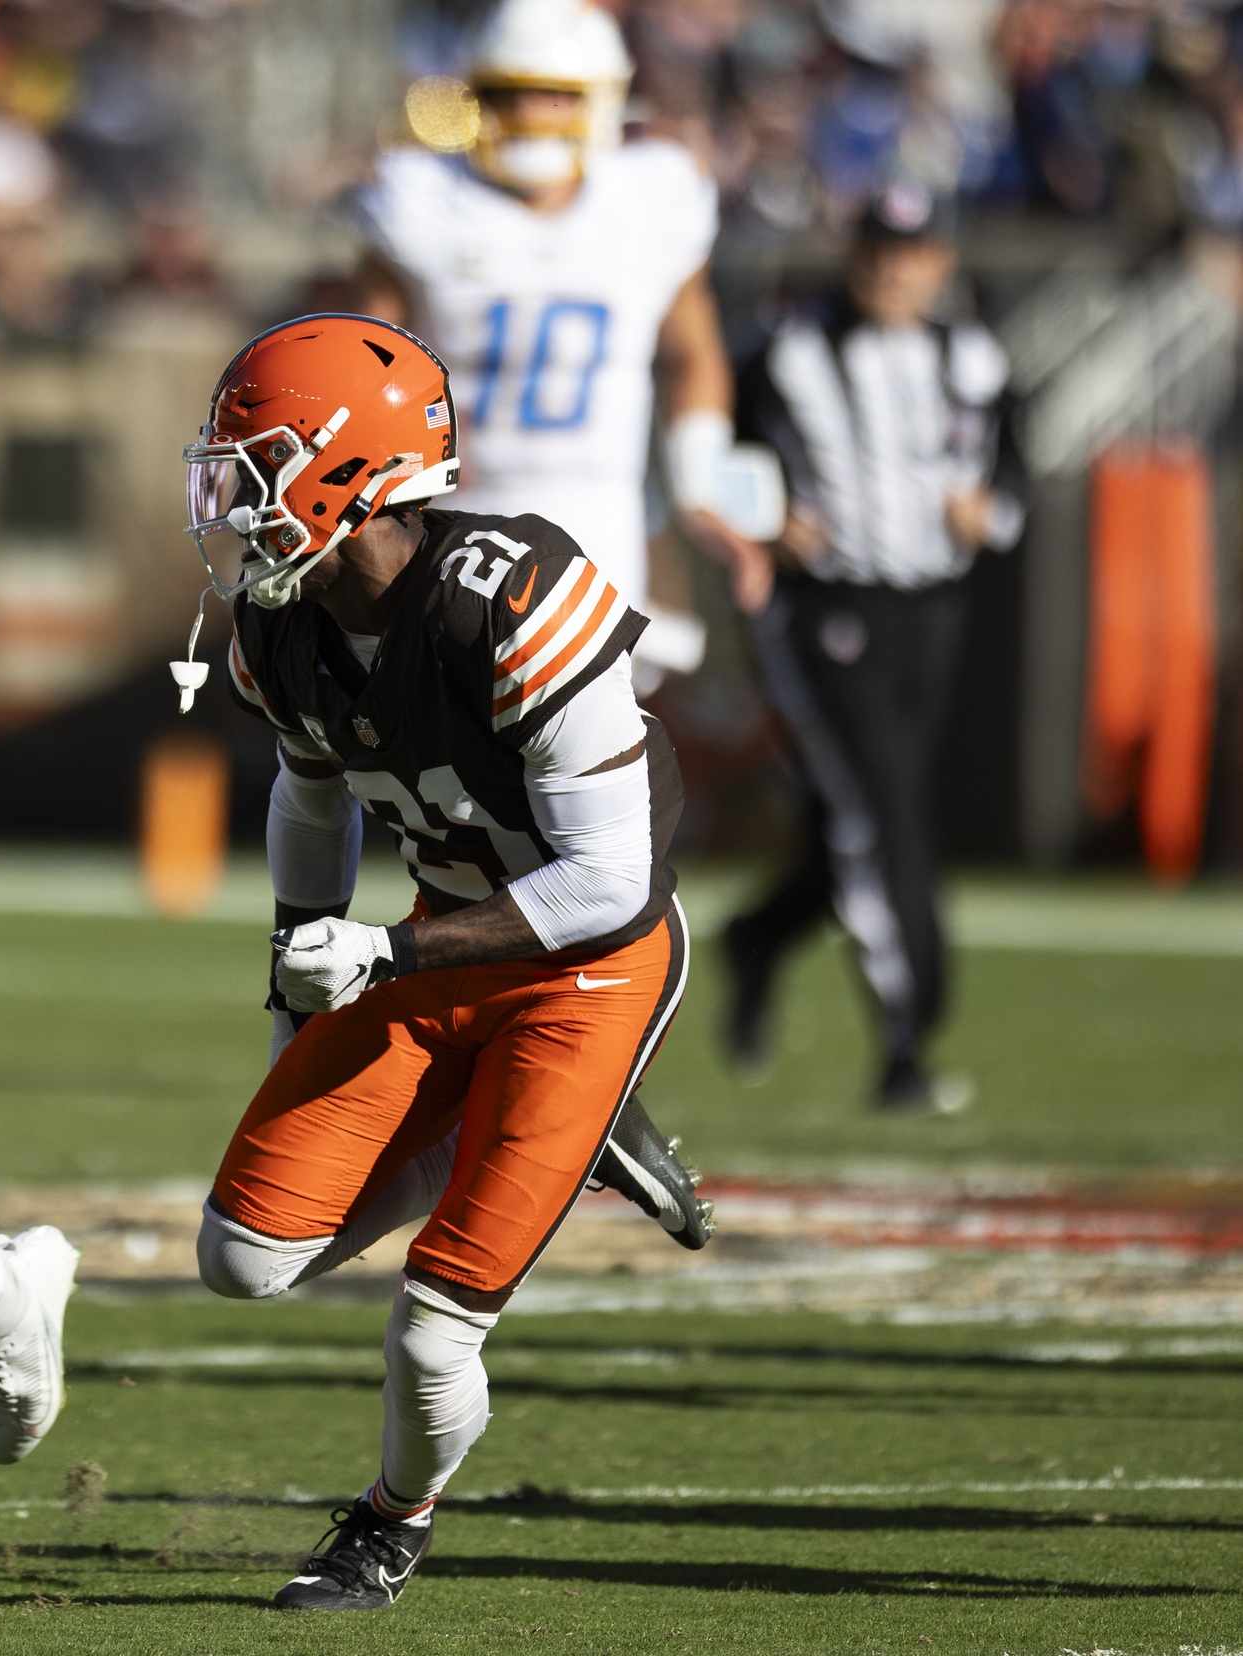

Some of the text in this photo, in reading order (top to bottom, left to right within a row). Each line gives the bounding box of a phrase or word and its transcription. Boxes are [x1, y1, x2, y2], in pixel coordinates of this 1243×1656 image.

[471, 297, 611, 429] 10
[439, 530, 533, 600] 21
[343, 764, 547, 902] 21
